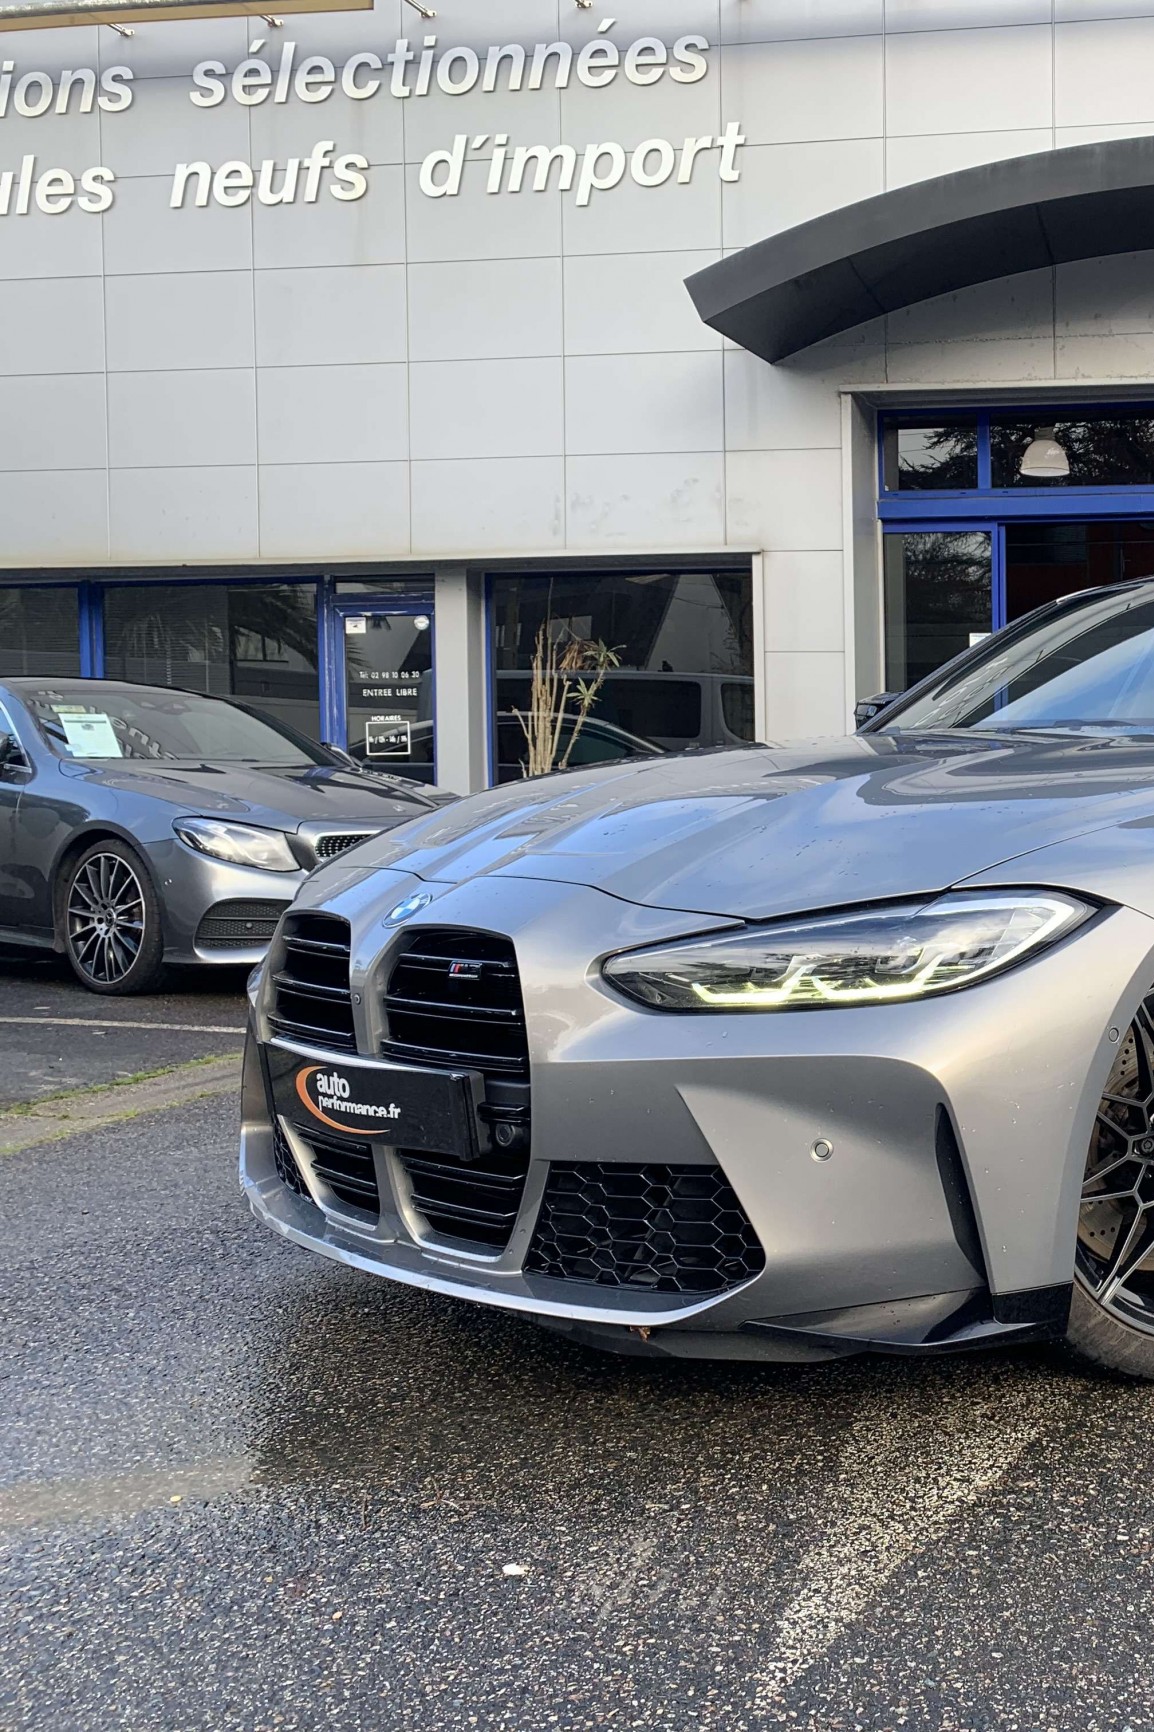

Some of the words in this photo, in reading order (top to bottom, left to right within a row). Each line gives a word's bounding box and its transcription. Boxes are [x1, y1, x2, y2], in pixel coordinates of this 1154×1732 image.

[189, 17, 710, 108] sélectionnées
[169, 140, 369, 207] neufs
[371, 671, 379, 679] 02
[362, 688, 392, 697] ENTREE
[396, 688, 418, 696] LIBRE
[316, 1071, 350, 1098] auto
[318, 1095, 401, 1119] performance.fr
